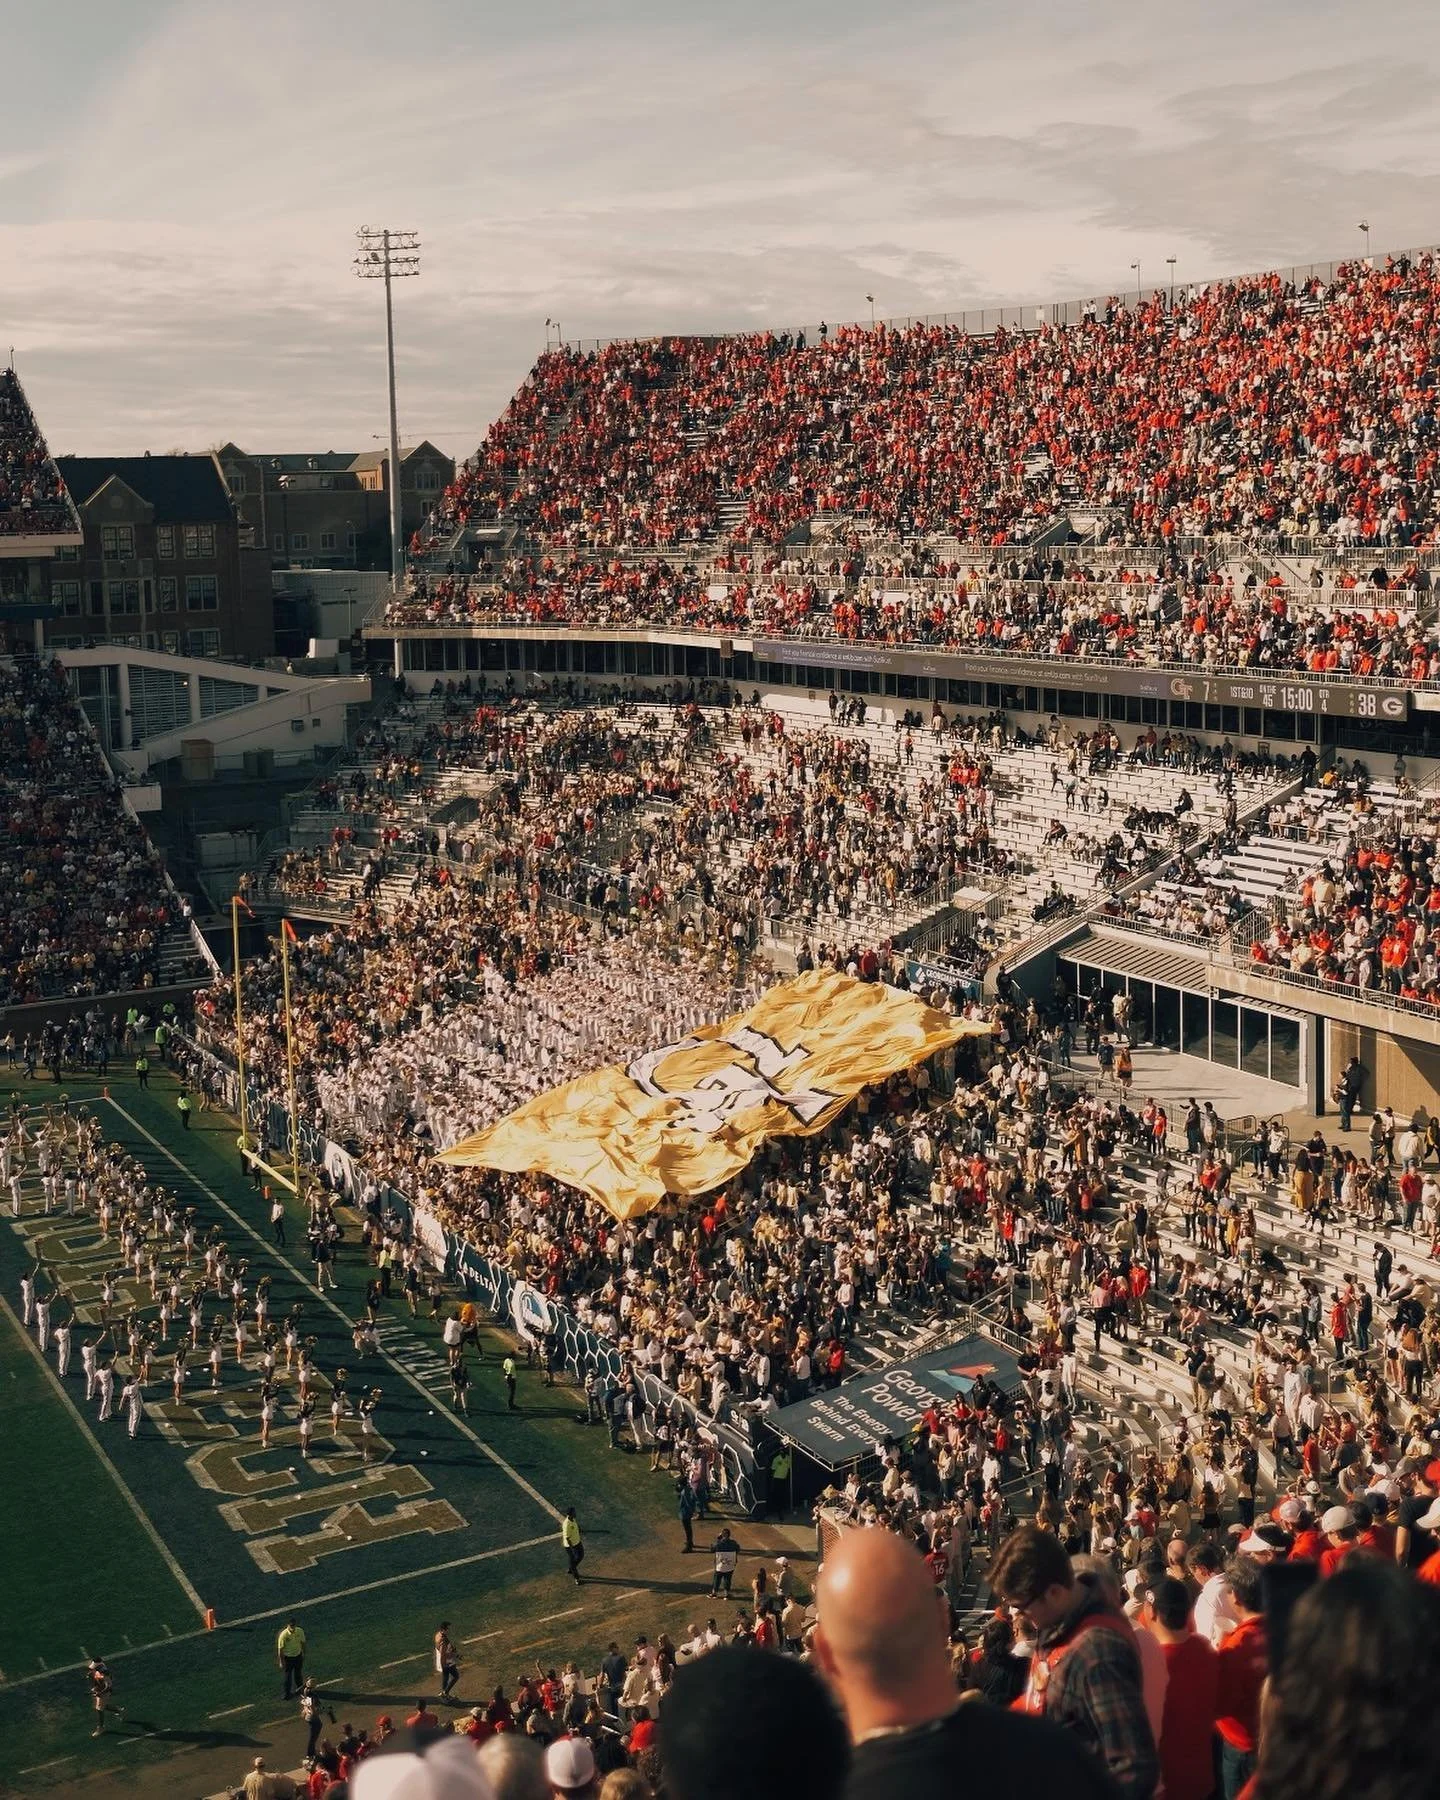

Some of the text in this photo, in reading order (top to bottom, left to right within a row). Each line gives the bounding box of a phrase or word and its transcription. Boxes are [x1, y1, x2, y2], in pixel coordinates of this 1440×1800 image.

[1203, 681, 1210, 701] 7
[1262, 694, 1273, 707] 45
[1280, 687, 1313, 711] 15:00
[1321, 699, 1328, 712] 4
[469, 1267, 494, 1293] DELTA
[833, 1395, 893, 1435] The Energy
[860, 1382, 922, 1423] Power
[808, 1416, 846, 1442] Swarm
[810, 1400, 881, 1445] Behind Every
[935, 1564, 944, 1575] 16
